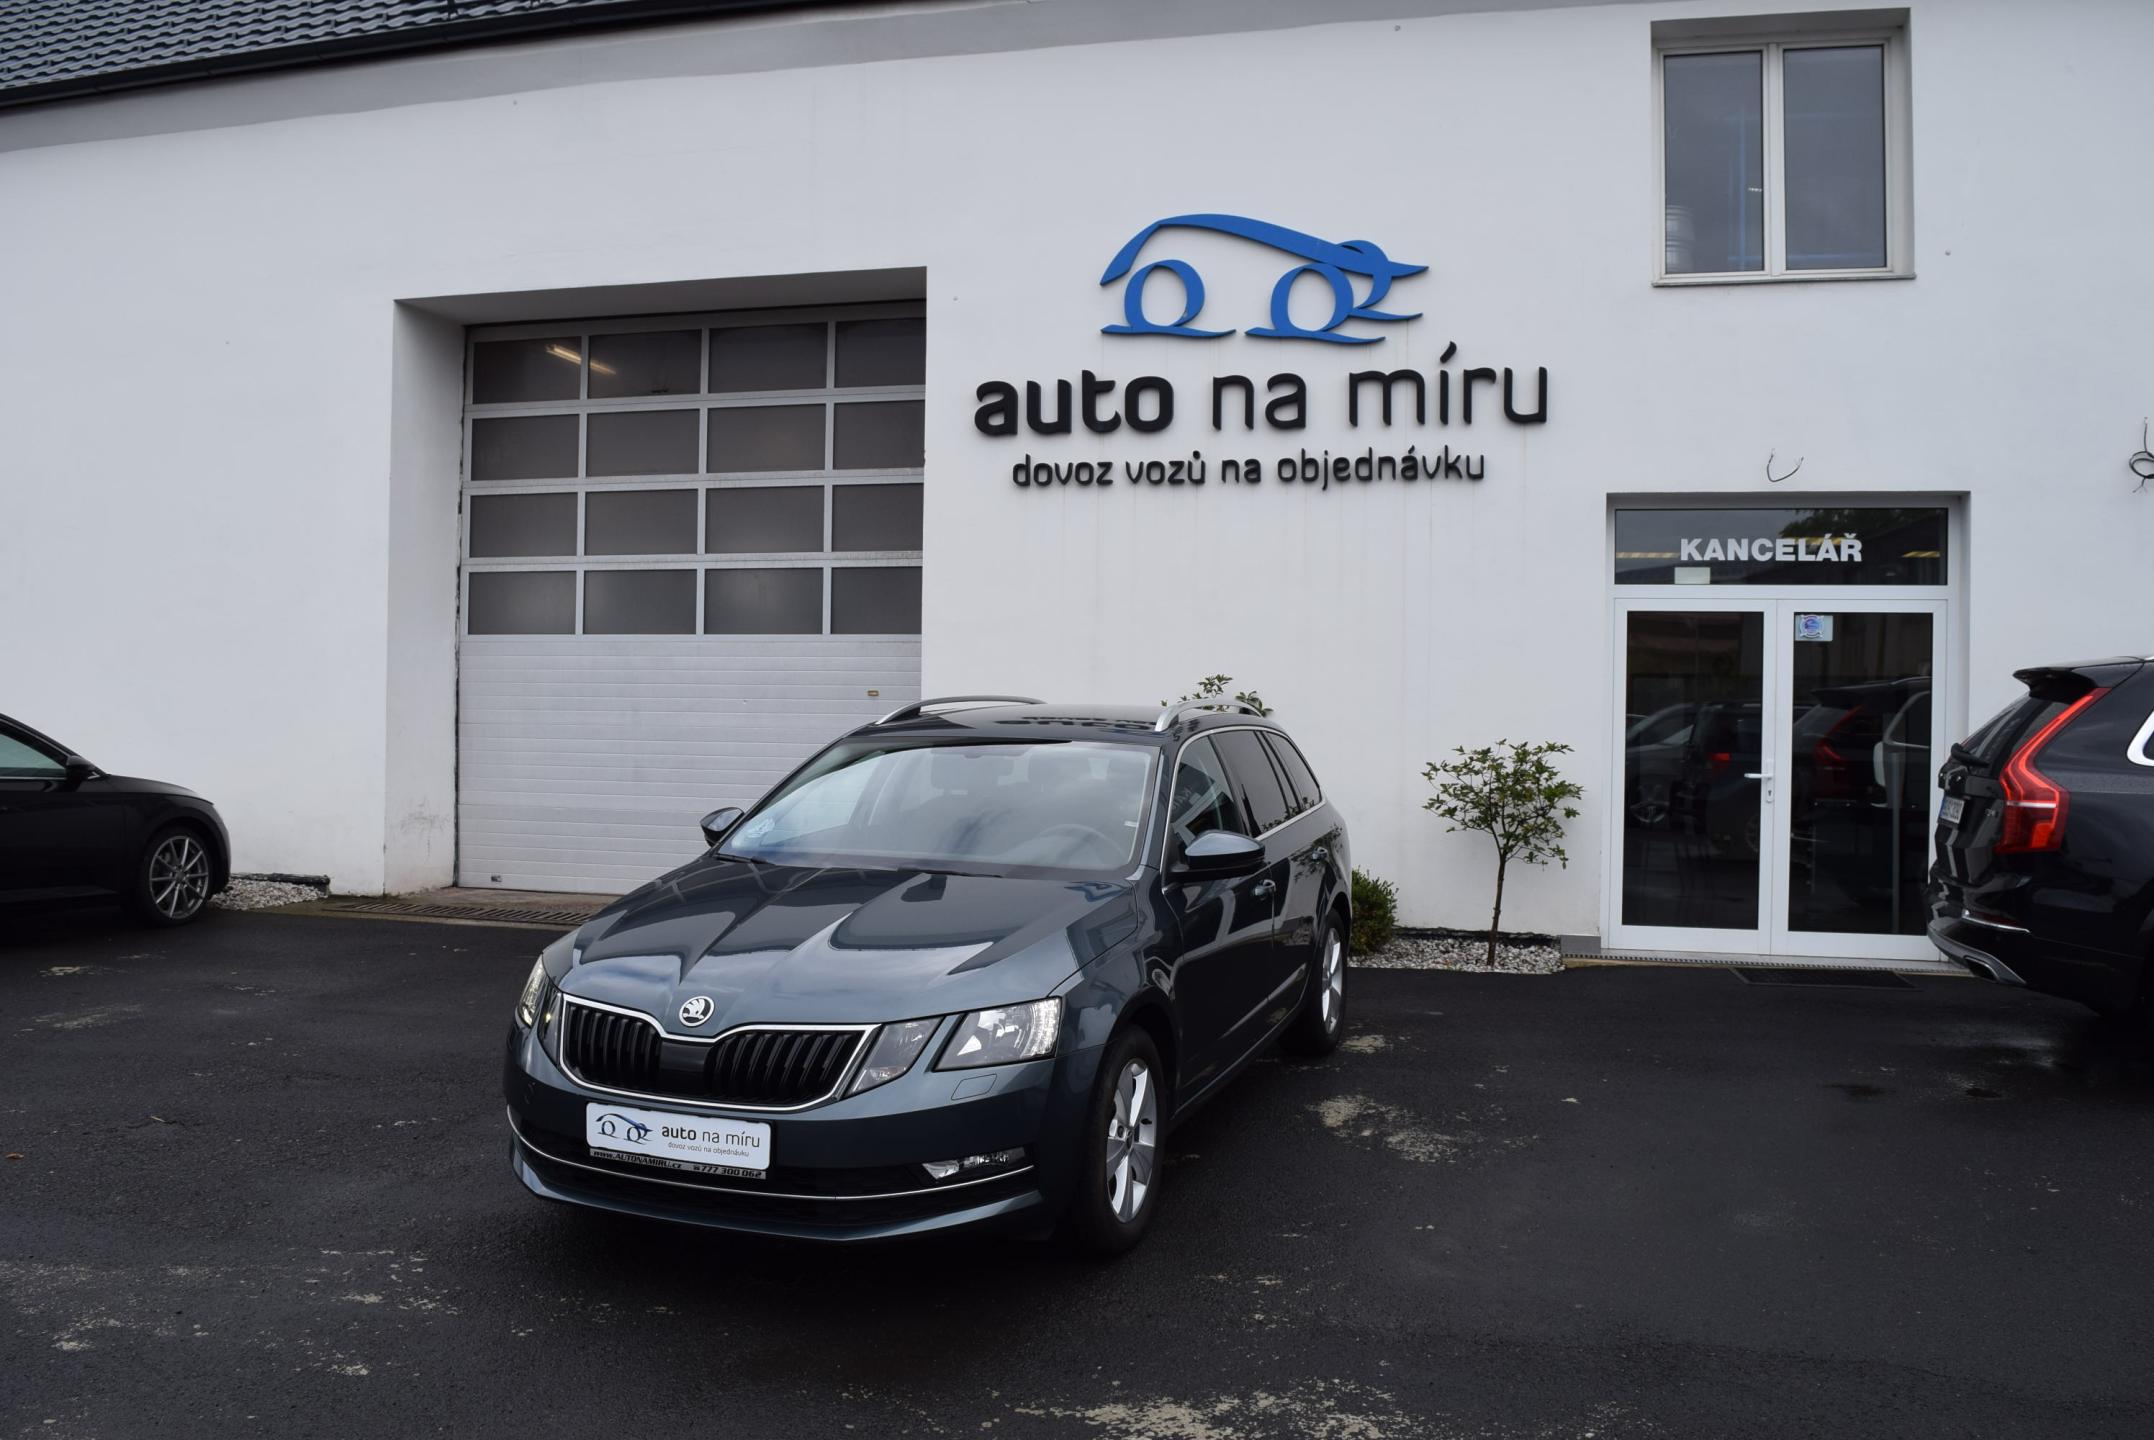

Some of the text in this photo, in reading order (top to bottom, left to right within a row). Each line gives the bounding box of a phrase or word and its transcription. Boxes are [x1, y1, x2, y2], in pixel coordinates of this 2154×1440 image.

[974, 341, 1548, 437] auto na míru
[1012, 445, 1486, 490] dovoz vozů na objednávku
[1680, 533, 1862, 562] KANCELÁŘ
[661, 1126, 760, 1148] auto na míru
[667, 1141, 686, 1150] dovoz
[686, 1143, 702, 1152] vozů
